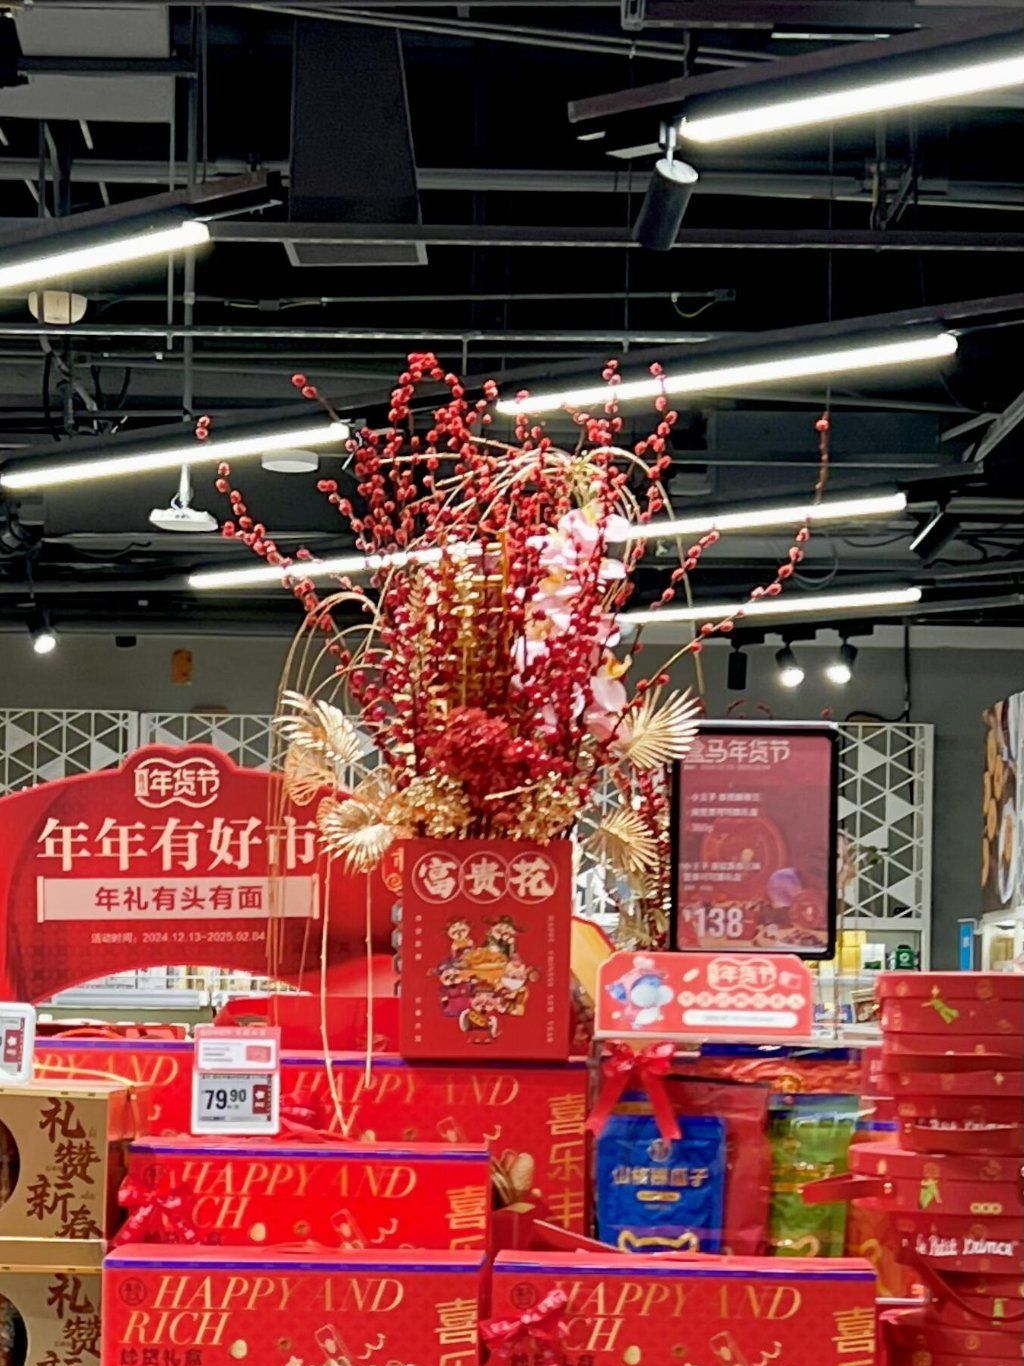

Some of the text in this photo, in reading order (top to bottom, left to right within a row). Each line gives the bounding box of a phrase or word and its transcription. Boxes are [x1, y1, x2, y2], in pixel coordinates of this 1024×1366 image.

[149, 768, 220, 796] 年货节
[36, 815, 318, 873] 年年有好市
[418, 856, 555, 899] 富贵花
[94, 885, 264, 912] 年礼有头有面
[294, 1072, 420, 1105] HAPPY
[329, 1165, 418, 1199] AND
[150, 1275, 405, 1313] HAPPY AND
[710, 1283, 802, 1321] AND
[119, 1310, 233, 1347] RICH
